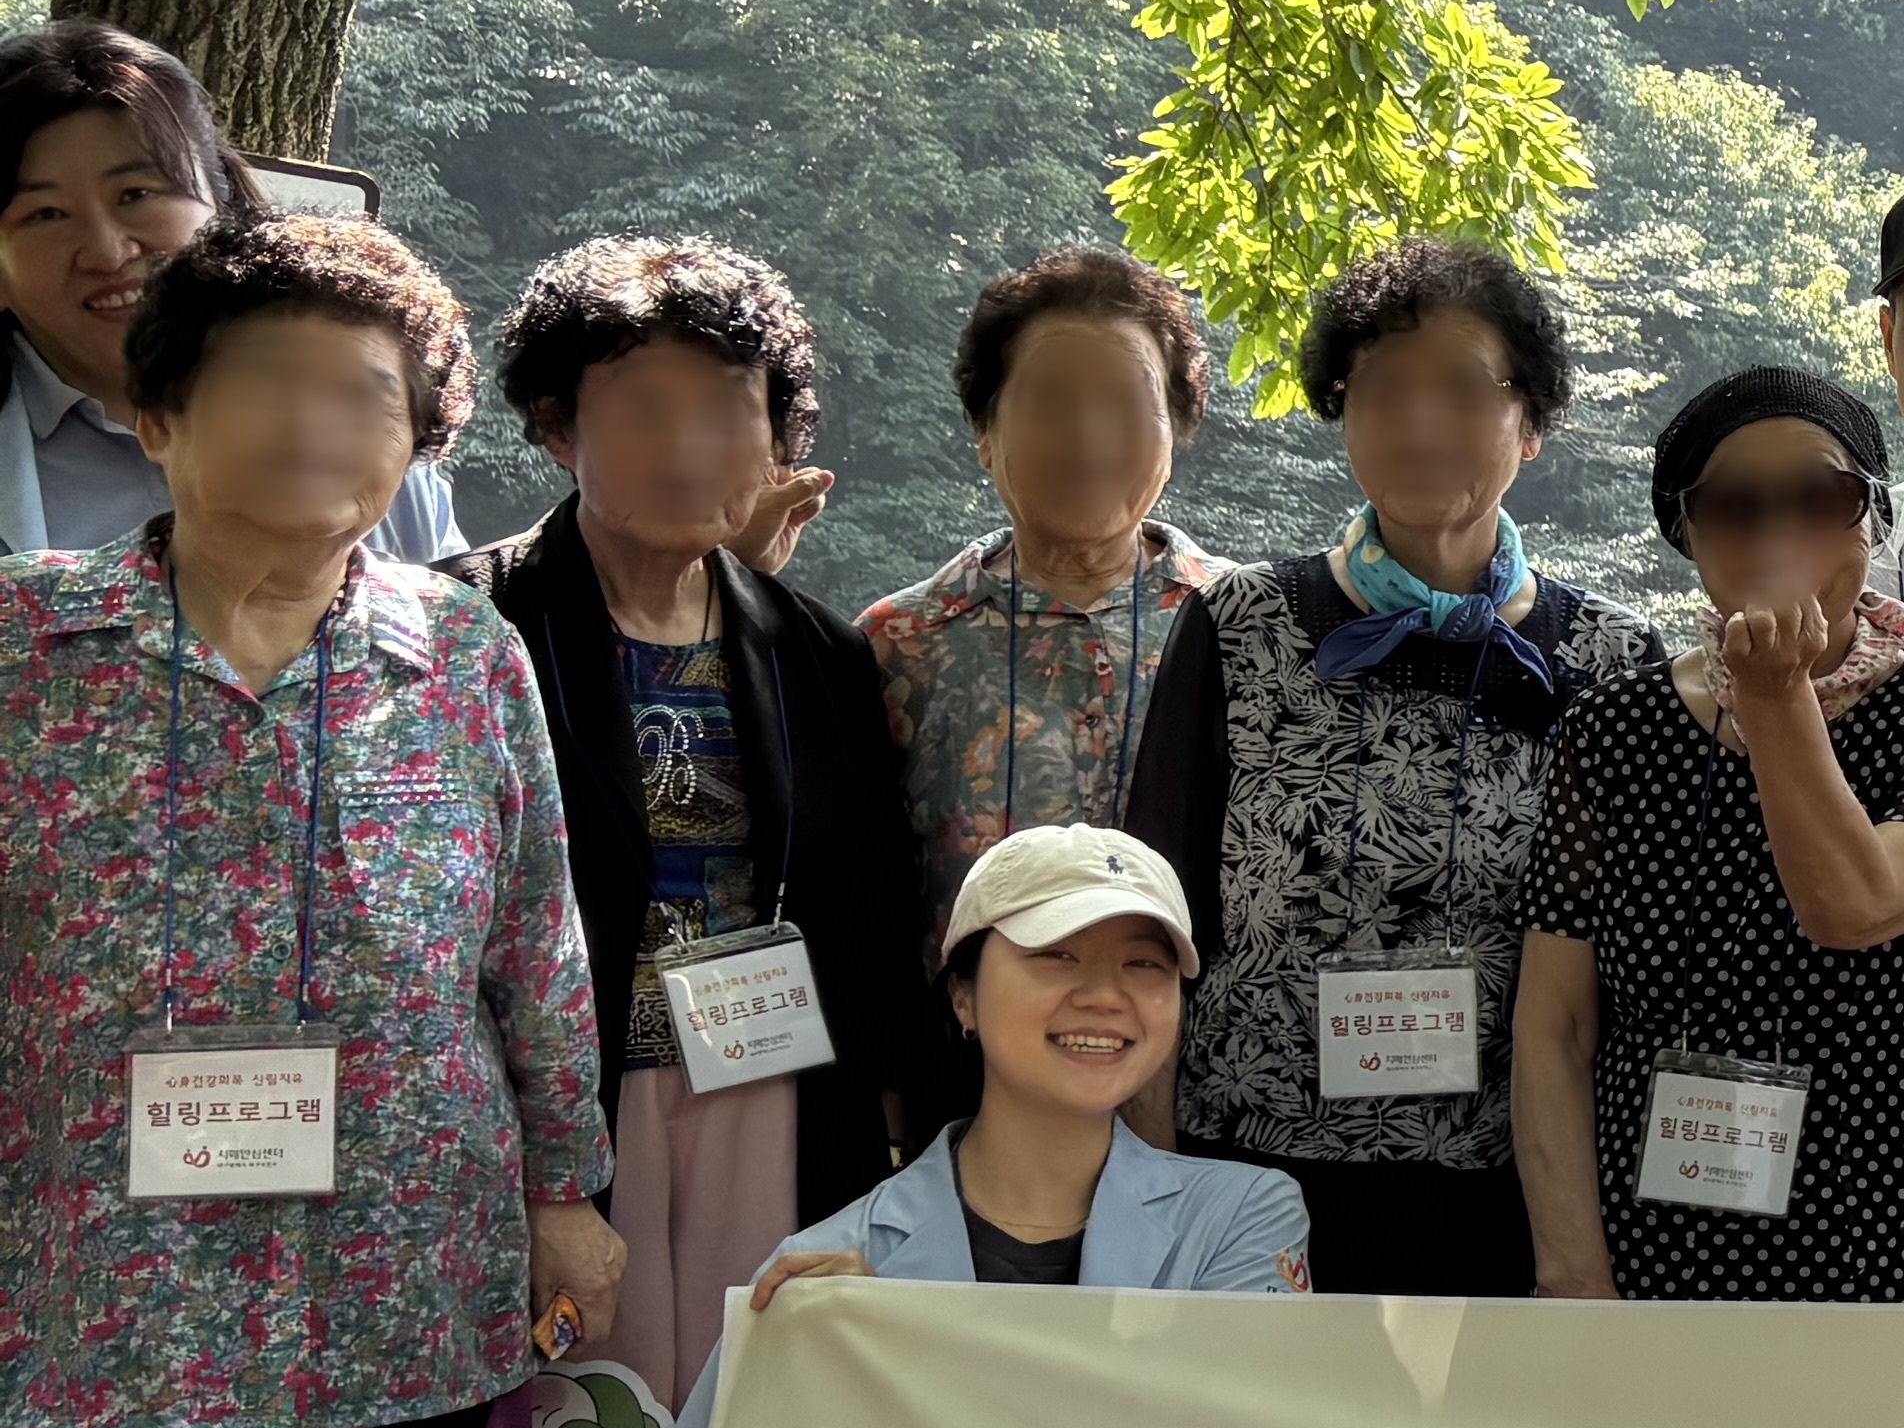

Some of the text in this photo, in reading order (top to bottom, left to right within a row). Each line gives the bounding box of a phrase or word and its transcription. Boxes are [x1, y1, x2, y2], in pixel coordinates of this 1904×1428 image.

[686, 986, 809, 1032] 힐링프로그램
[1329, 1012, 1466, 1038] 힐링프로그램
[146, 1098, 322, 1128] 힐링프로그램
[1659, 1115, 1789, 1154] 힐링프로그램
